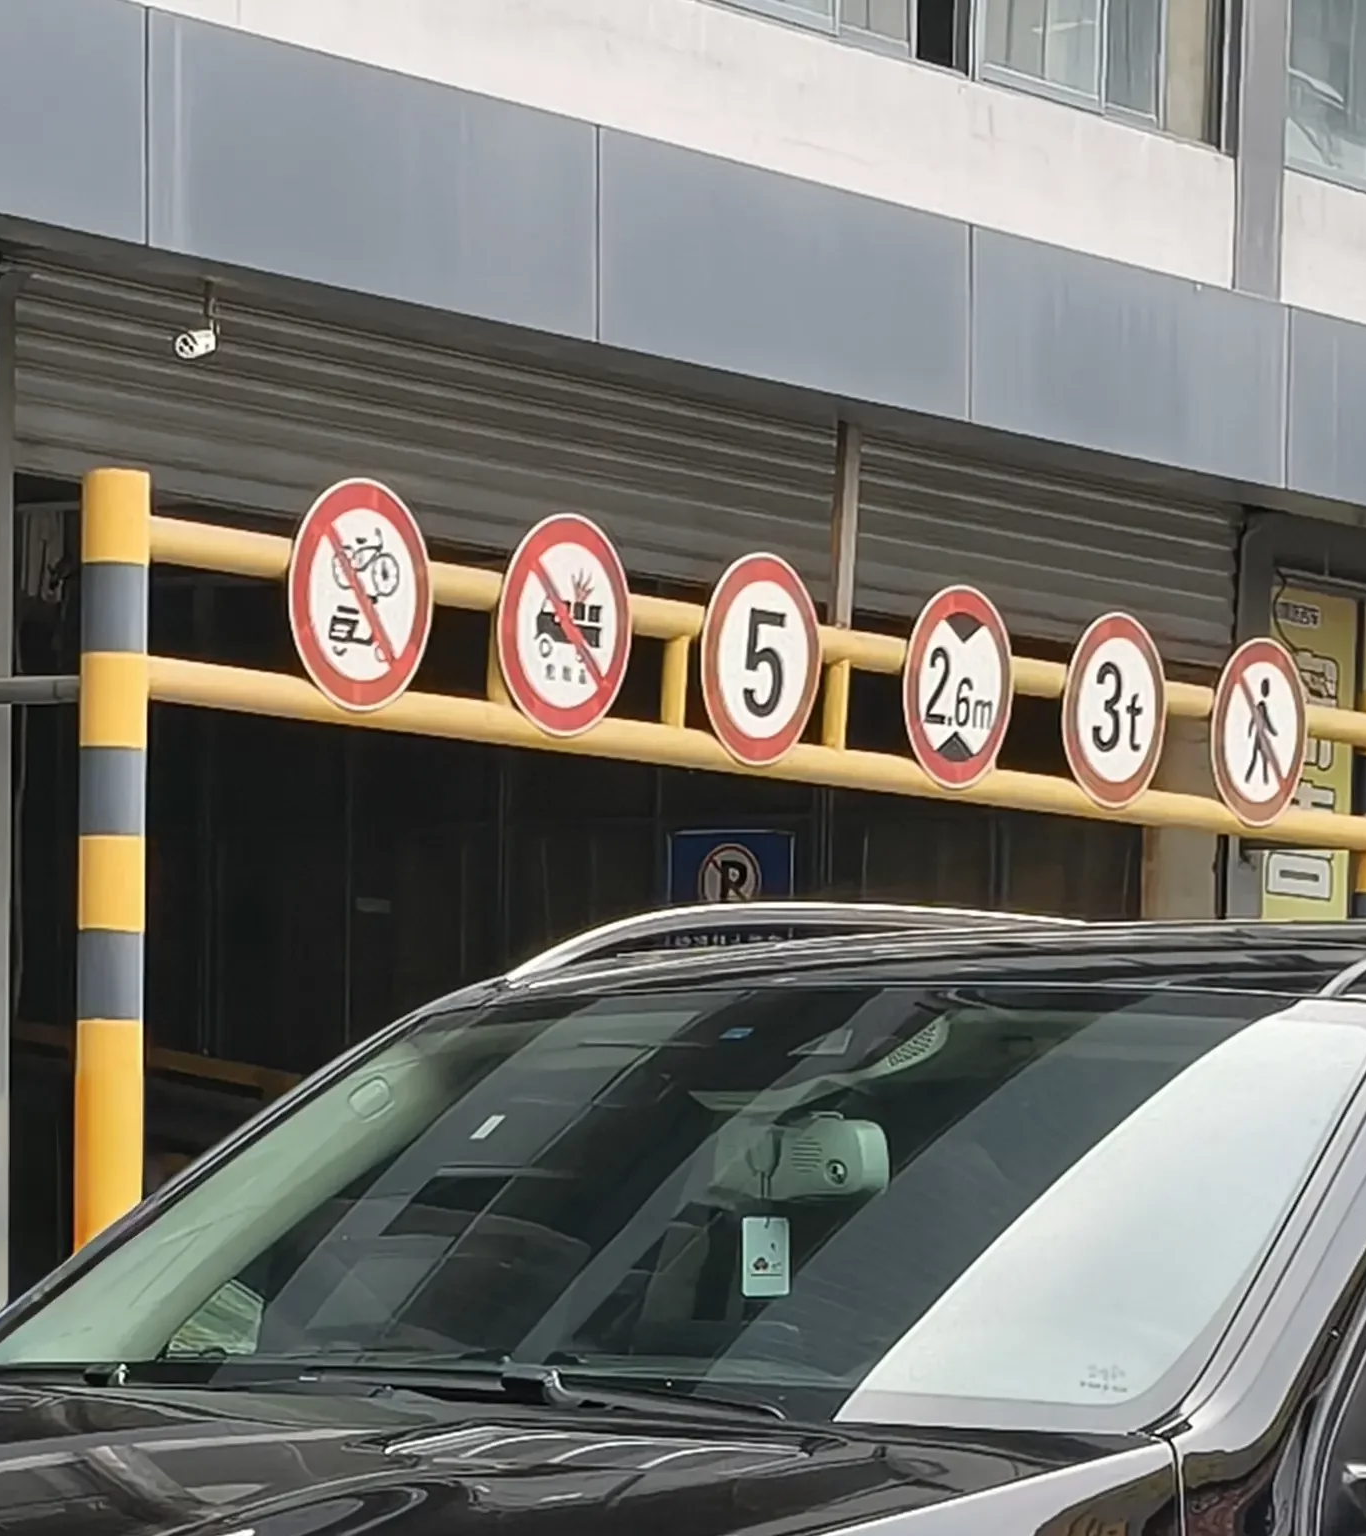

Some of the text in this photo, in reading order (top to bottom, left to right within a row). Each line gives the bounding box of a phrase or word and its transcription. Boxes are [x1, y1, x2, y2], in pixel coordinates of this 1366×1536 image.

[742, 607, 786, 718] 5
[924, 646, 993, 731] 2.6m
[1092, 660, 1144, 753] 3t
